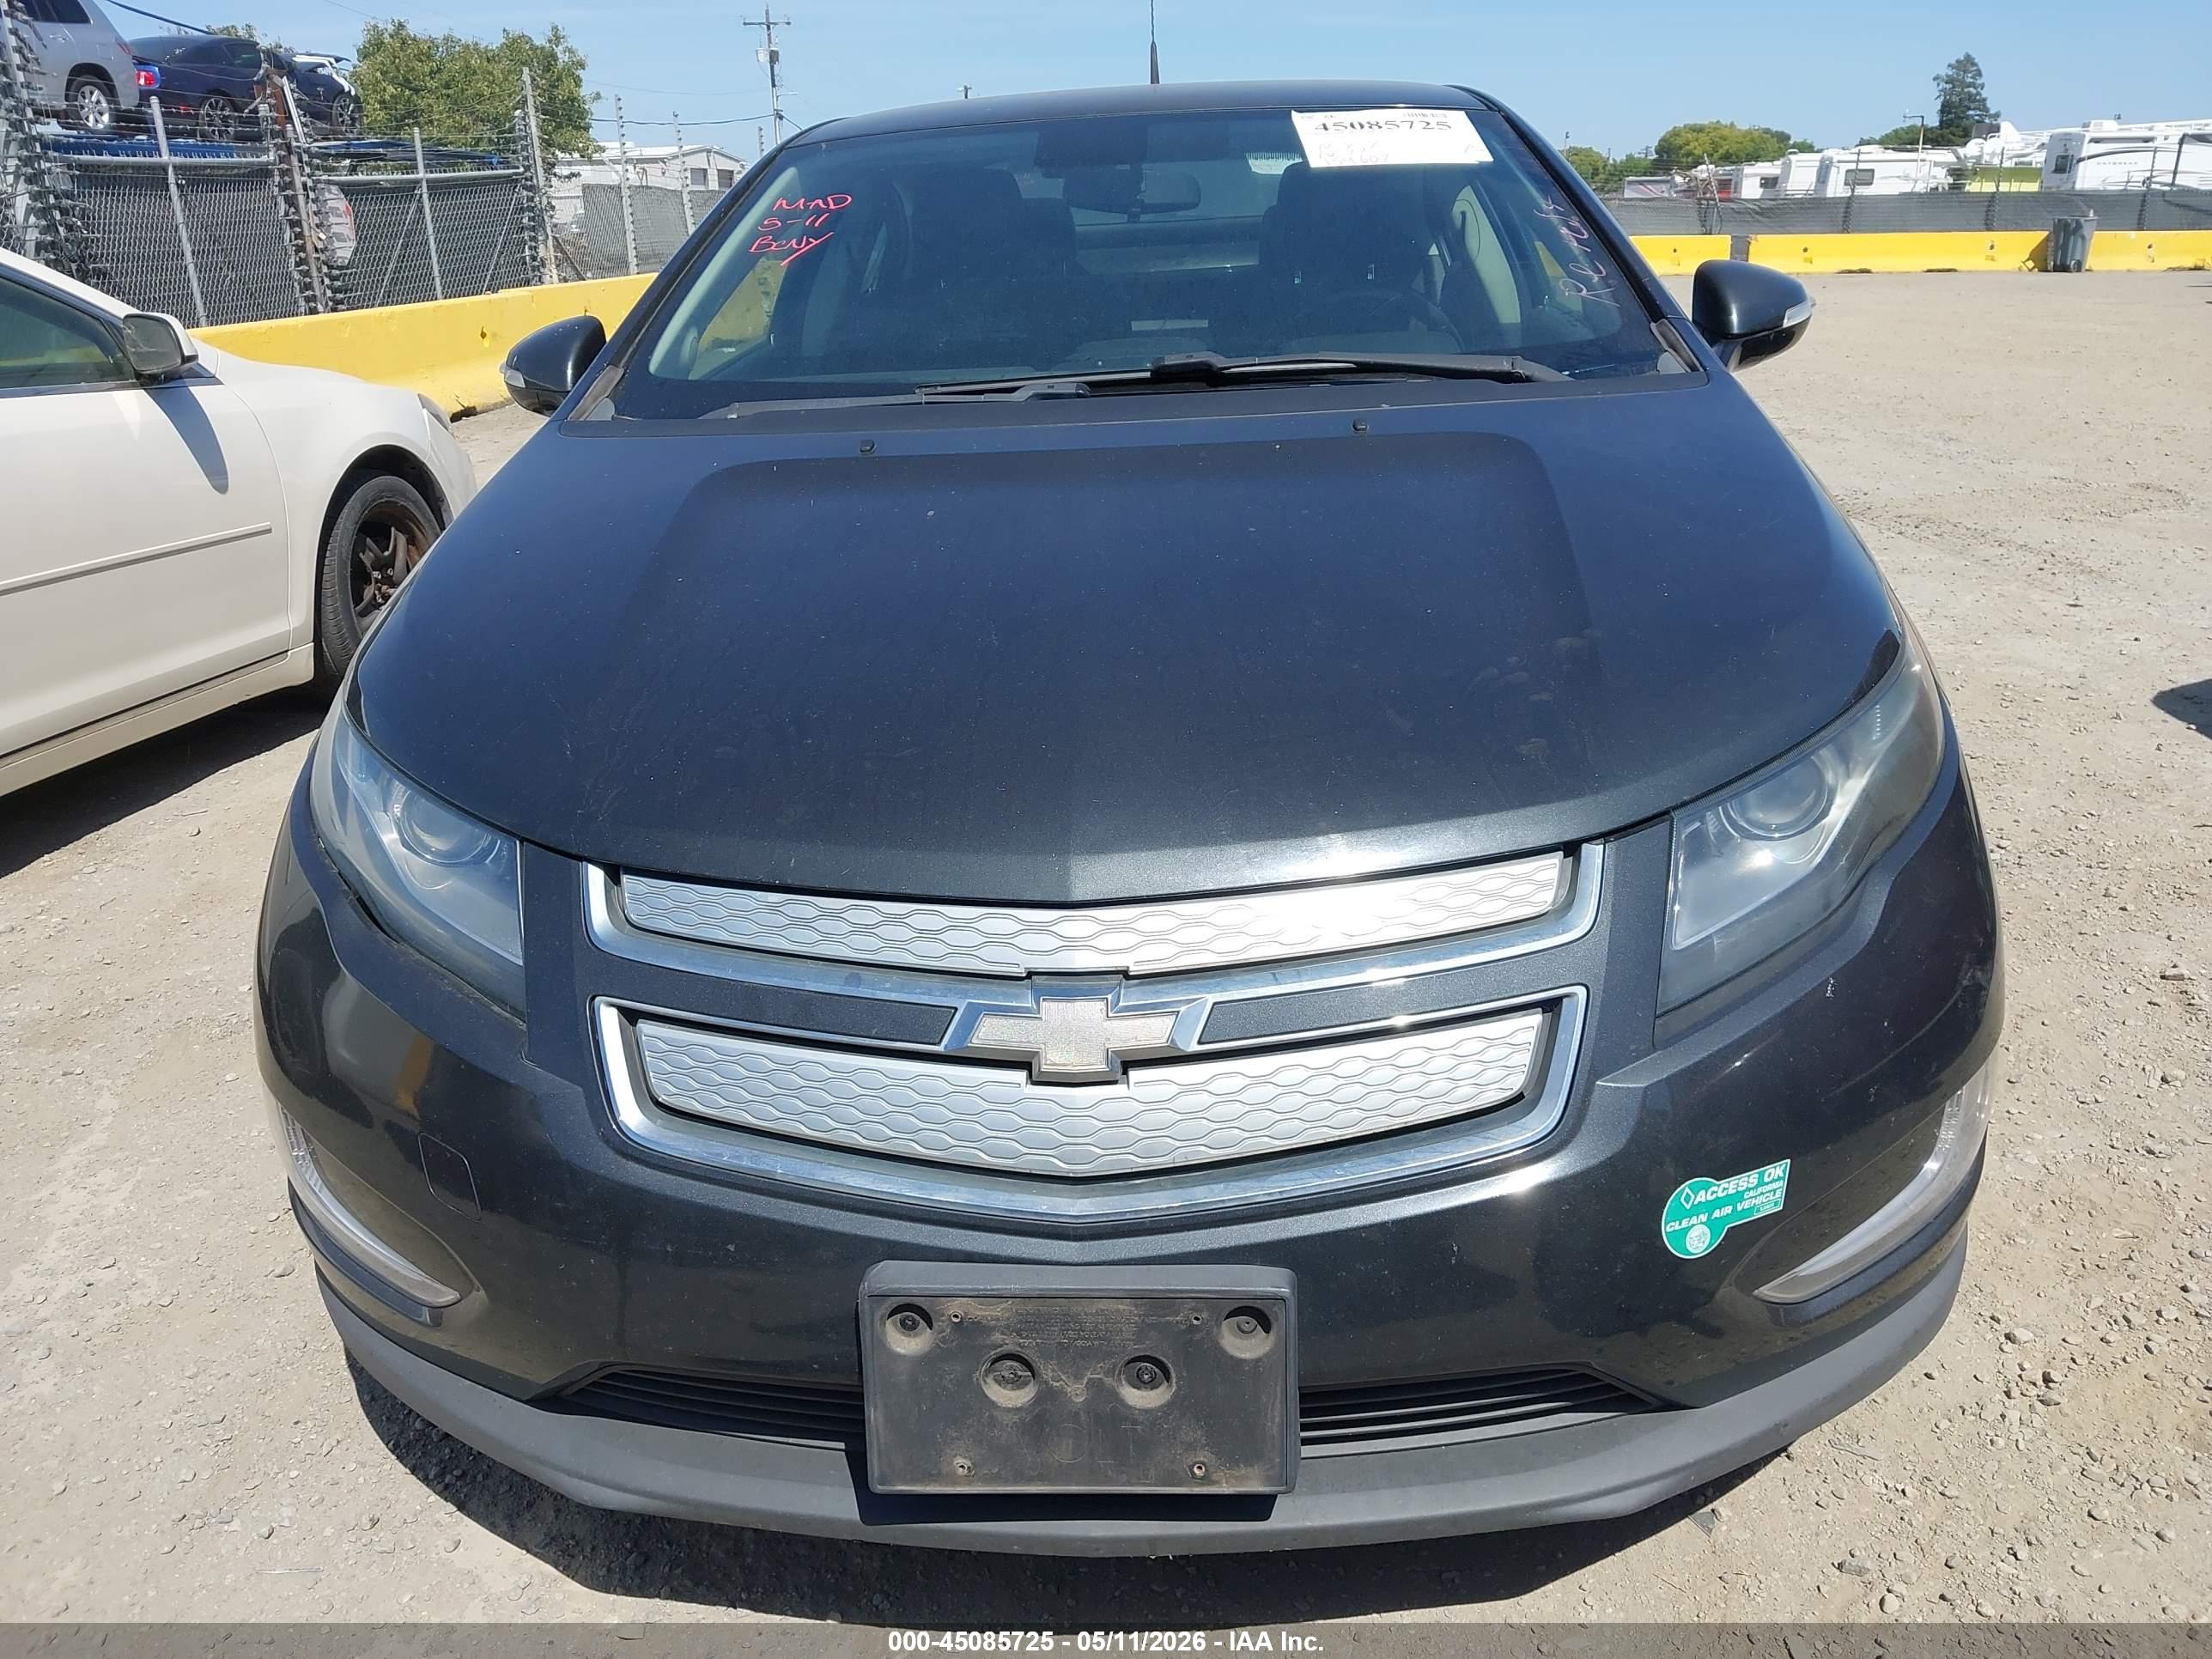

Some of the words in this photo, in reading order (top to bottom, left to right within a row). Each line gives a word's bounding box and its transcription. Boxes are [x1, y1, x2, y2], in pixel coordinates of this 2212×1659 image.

[1315, 120, 1452, 131] 45085725
[1693, 1173, 1759, 1205] ACCESS
[1764, 1164, 1786, 1182] OK
[1744, 1180, 1784, 1199] CALIFORNIA
[1666, 1212, 1708, 1232] CLEAN
[1711, 1205, 1733, 1219] AIR
[1737, 1188, 1783, 1212] VEHICLE
